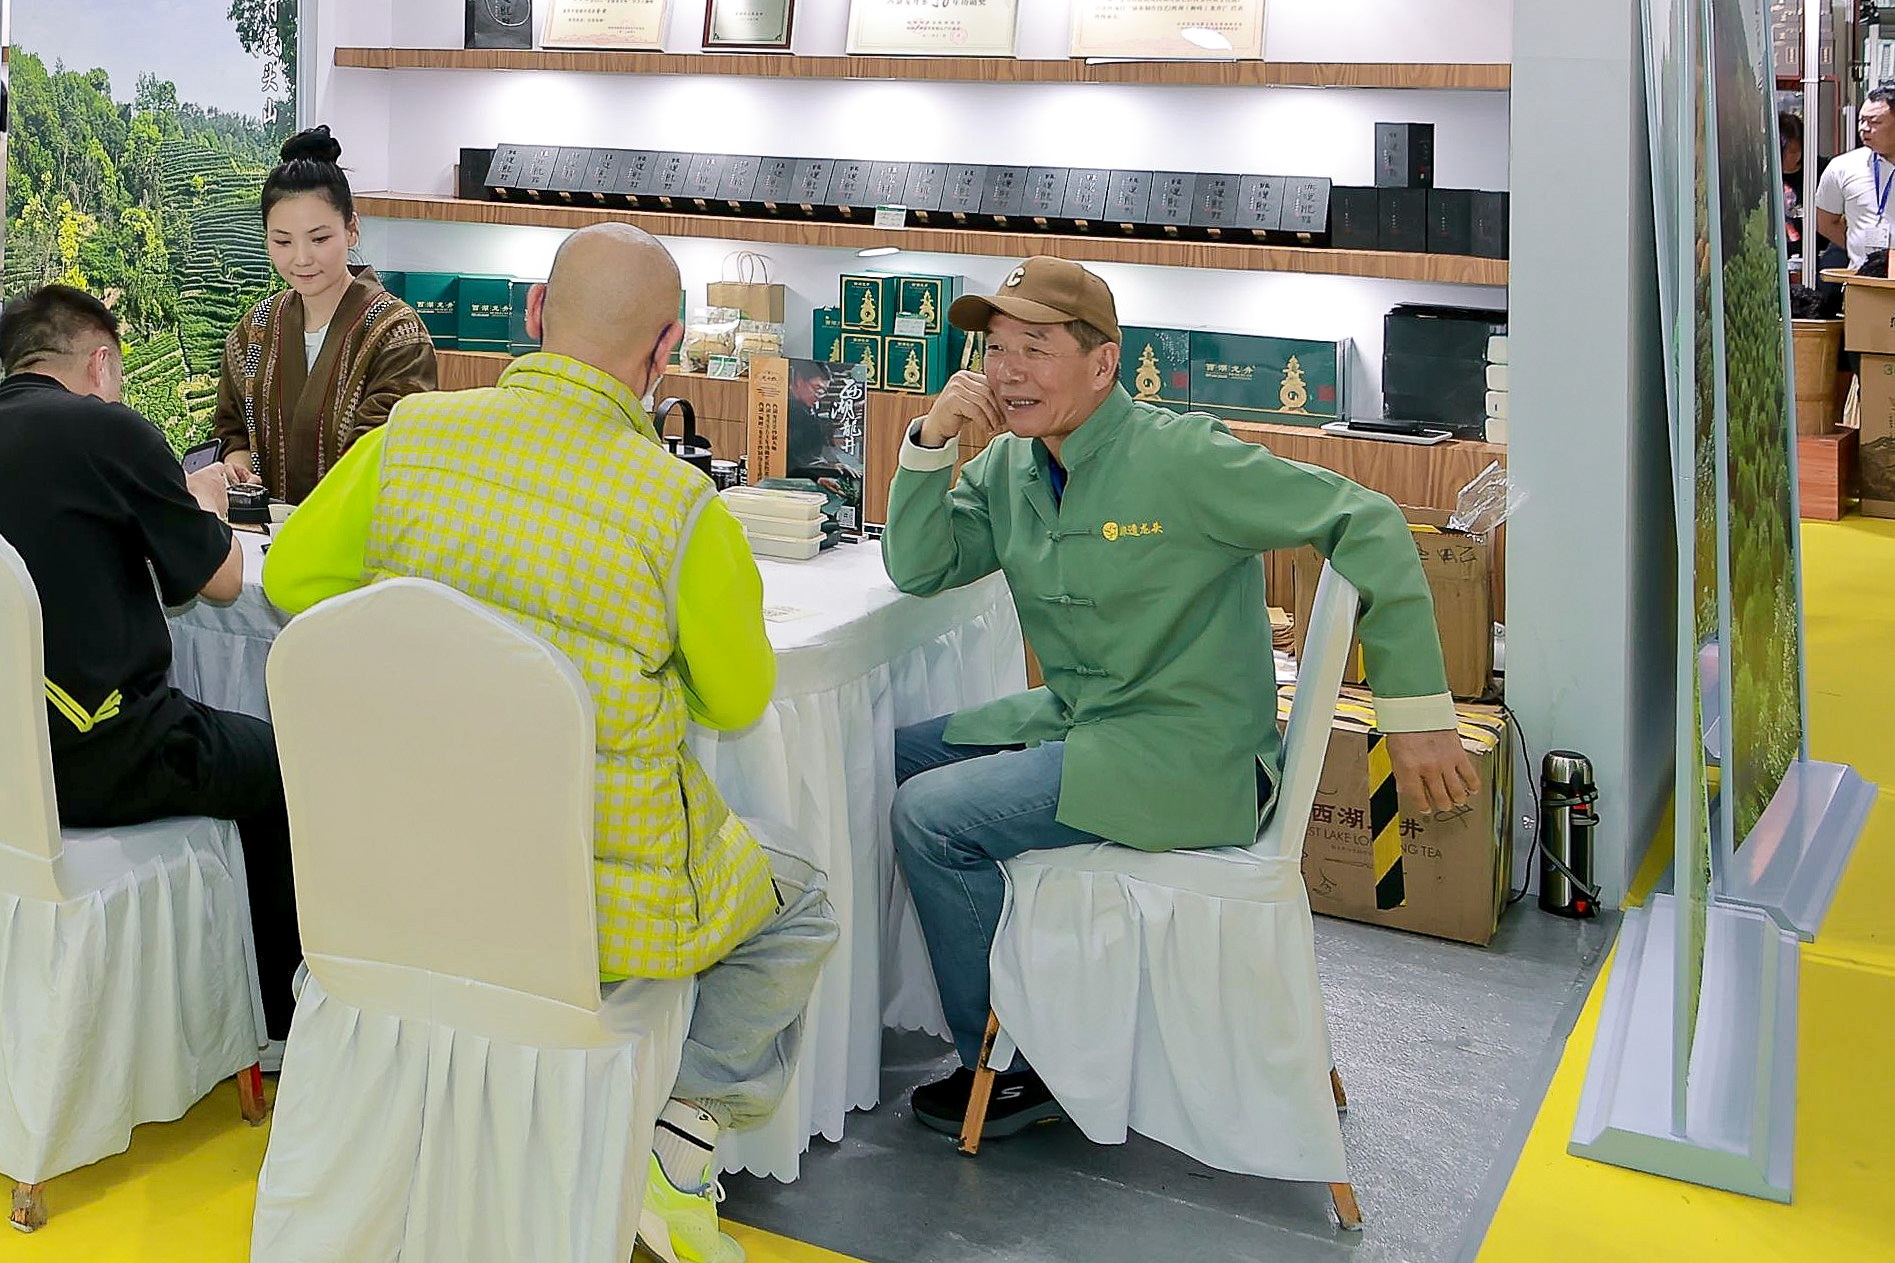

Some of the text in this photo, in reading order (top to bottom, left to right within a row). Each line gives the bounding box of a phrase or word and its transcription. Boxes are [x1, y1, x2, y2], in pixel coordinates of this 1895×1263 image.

[1311, 803, 1425, 840] 西湖井
[1421, 845, 1443, 859] TEA
